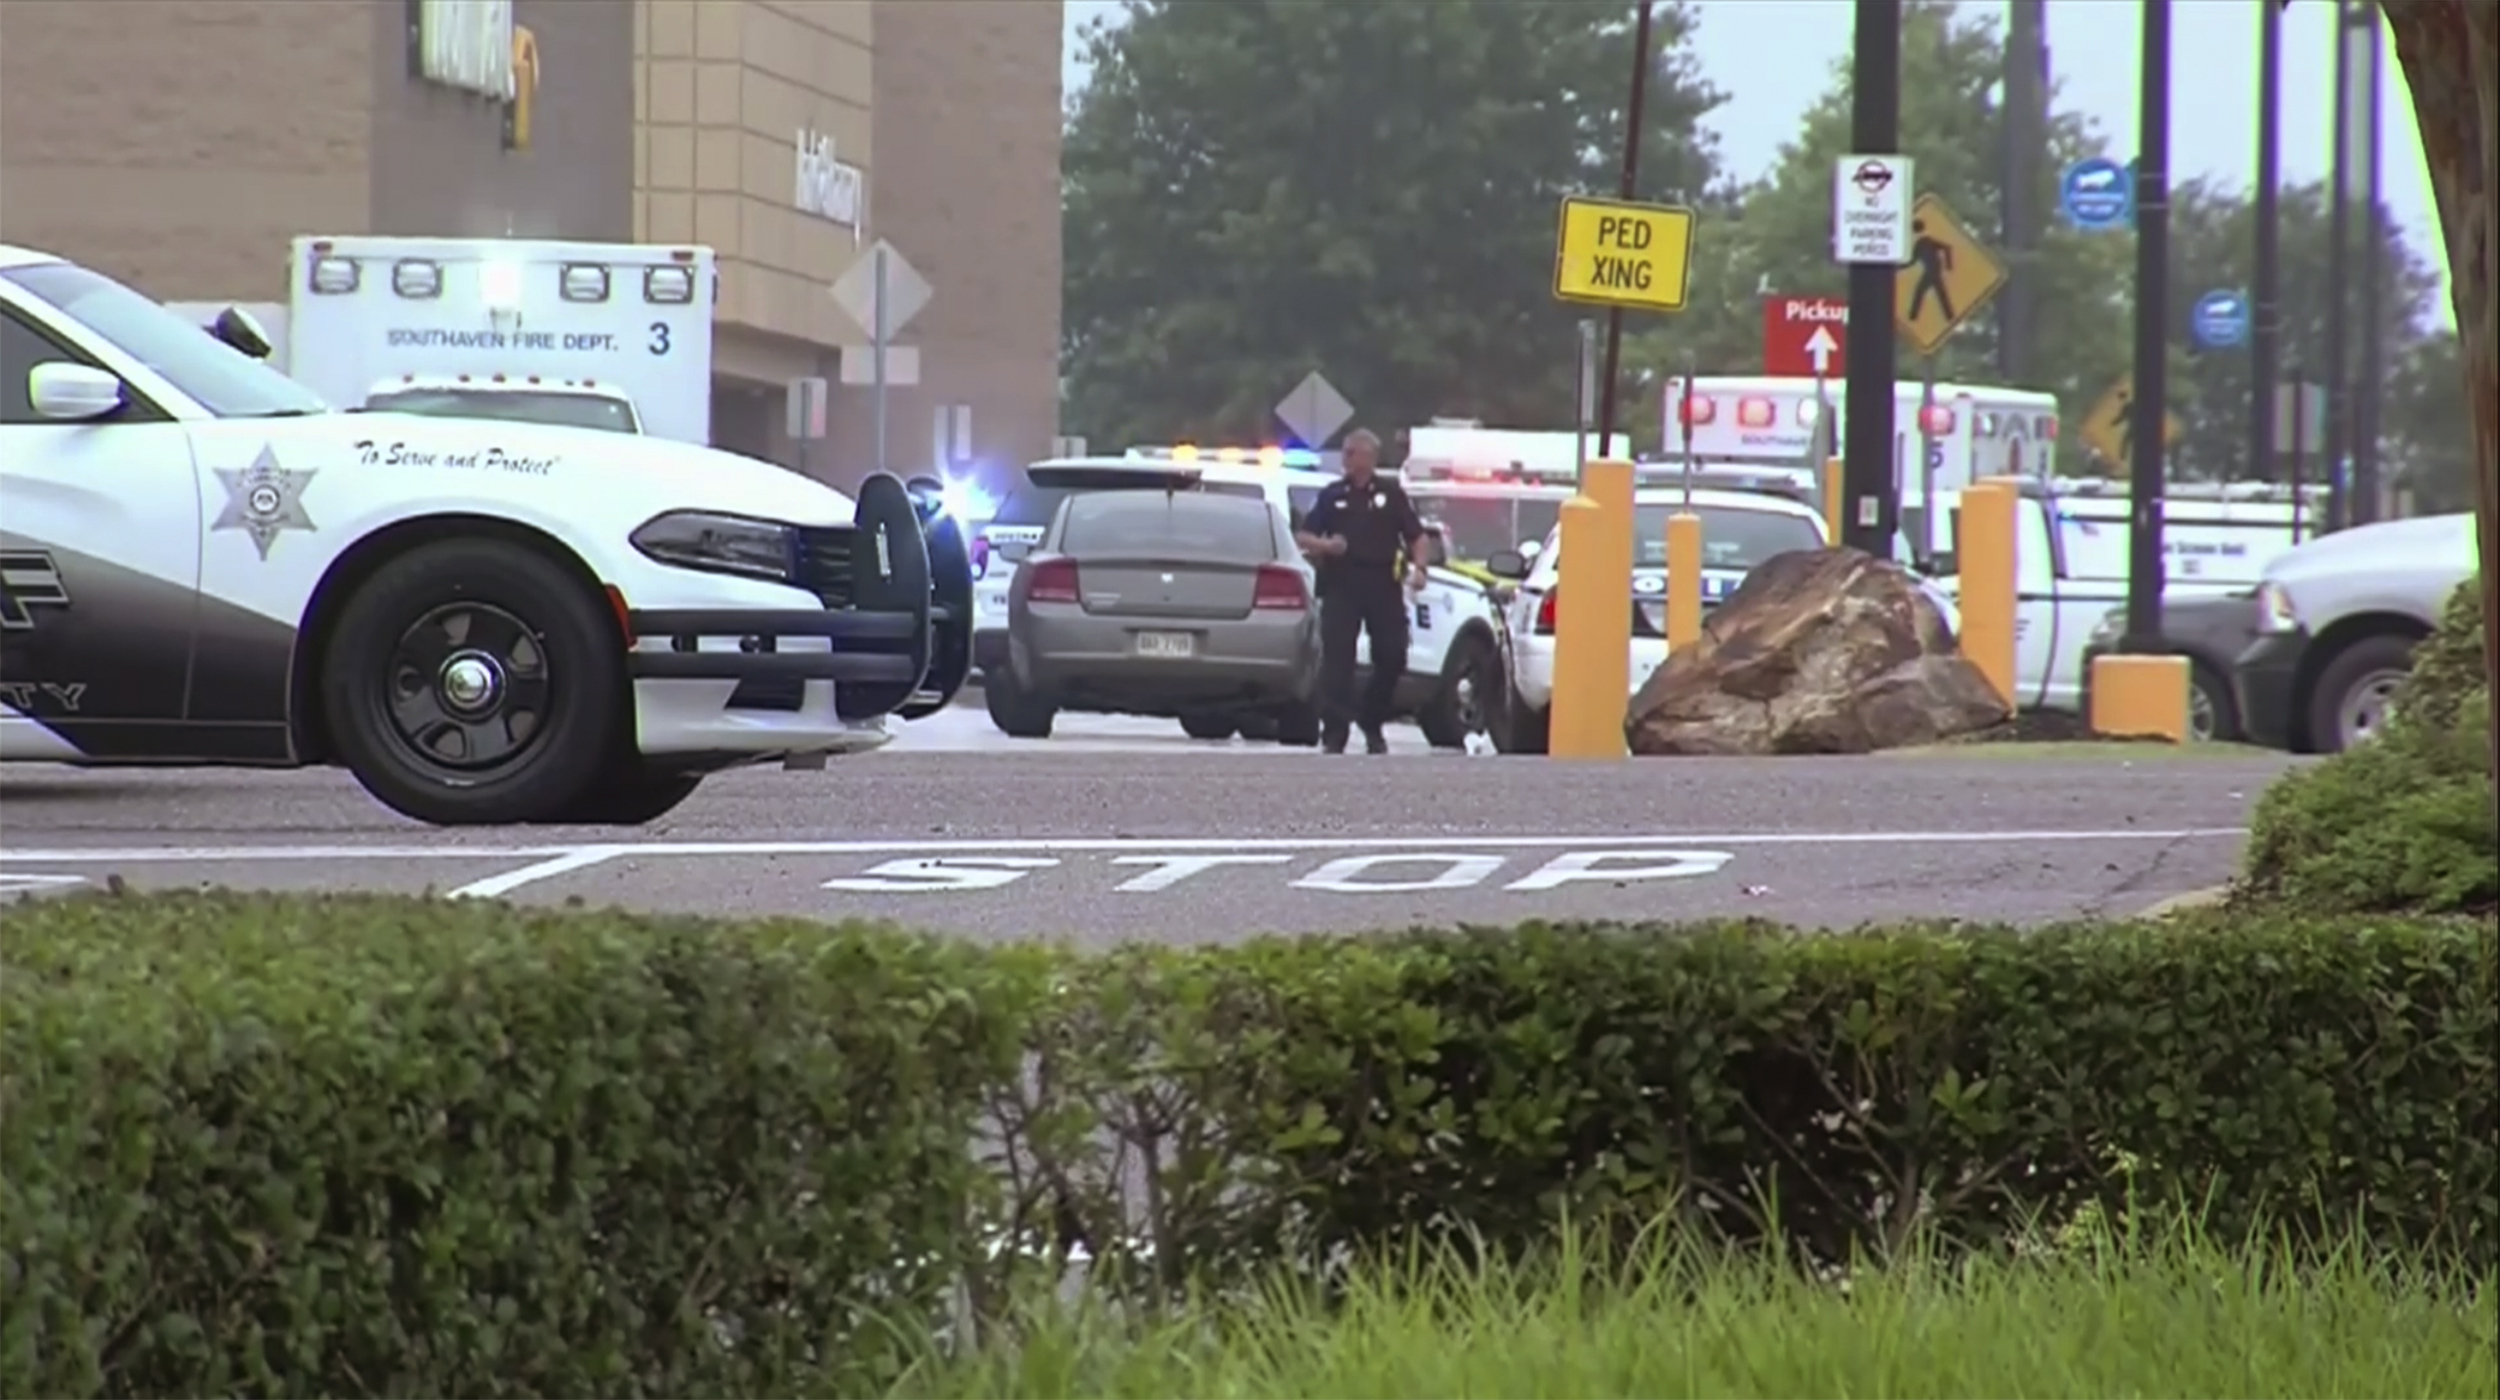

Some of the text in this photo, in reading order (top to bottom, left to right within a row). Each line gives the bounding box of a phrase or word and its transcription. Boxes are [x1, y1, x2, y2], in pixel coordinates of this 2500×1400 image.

[1598, 216, 1653, 249] PED
[1849, 227, 1894, 240] PARKING
[1591, 255, 1653, 290] XING
[387, 329, 619, 352] SOUTHAVEN FIRE DEPT.
[647, 321, 671, 357] 3
[385, 442, 437, 467] Serve
[443, 451, 481, 469] and
[820, 850, 1736, 893] STOP
